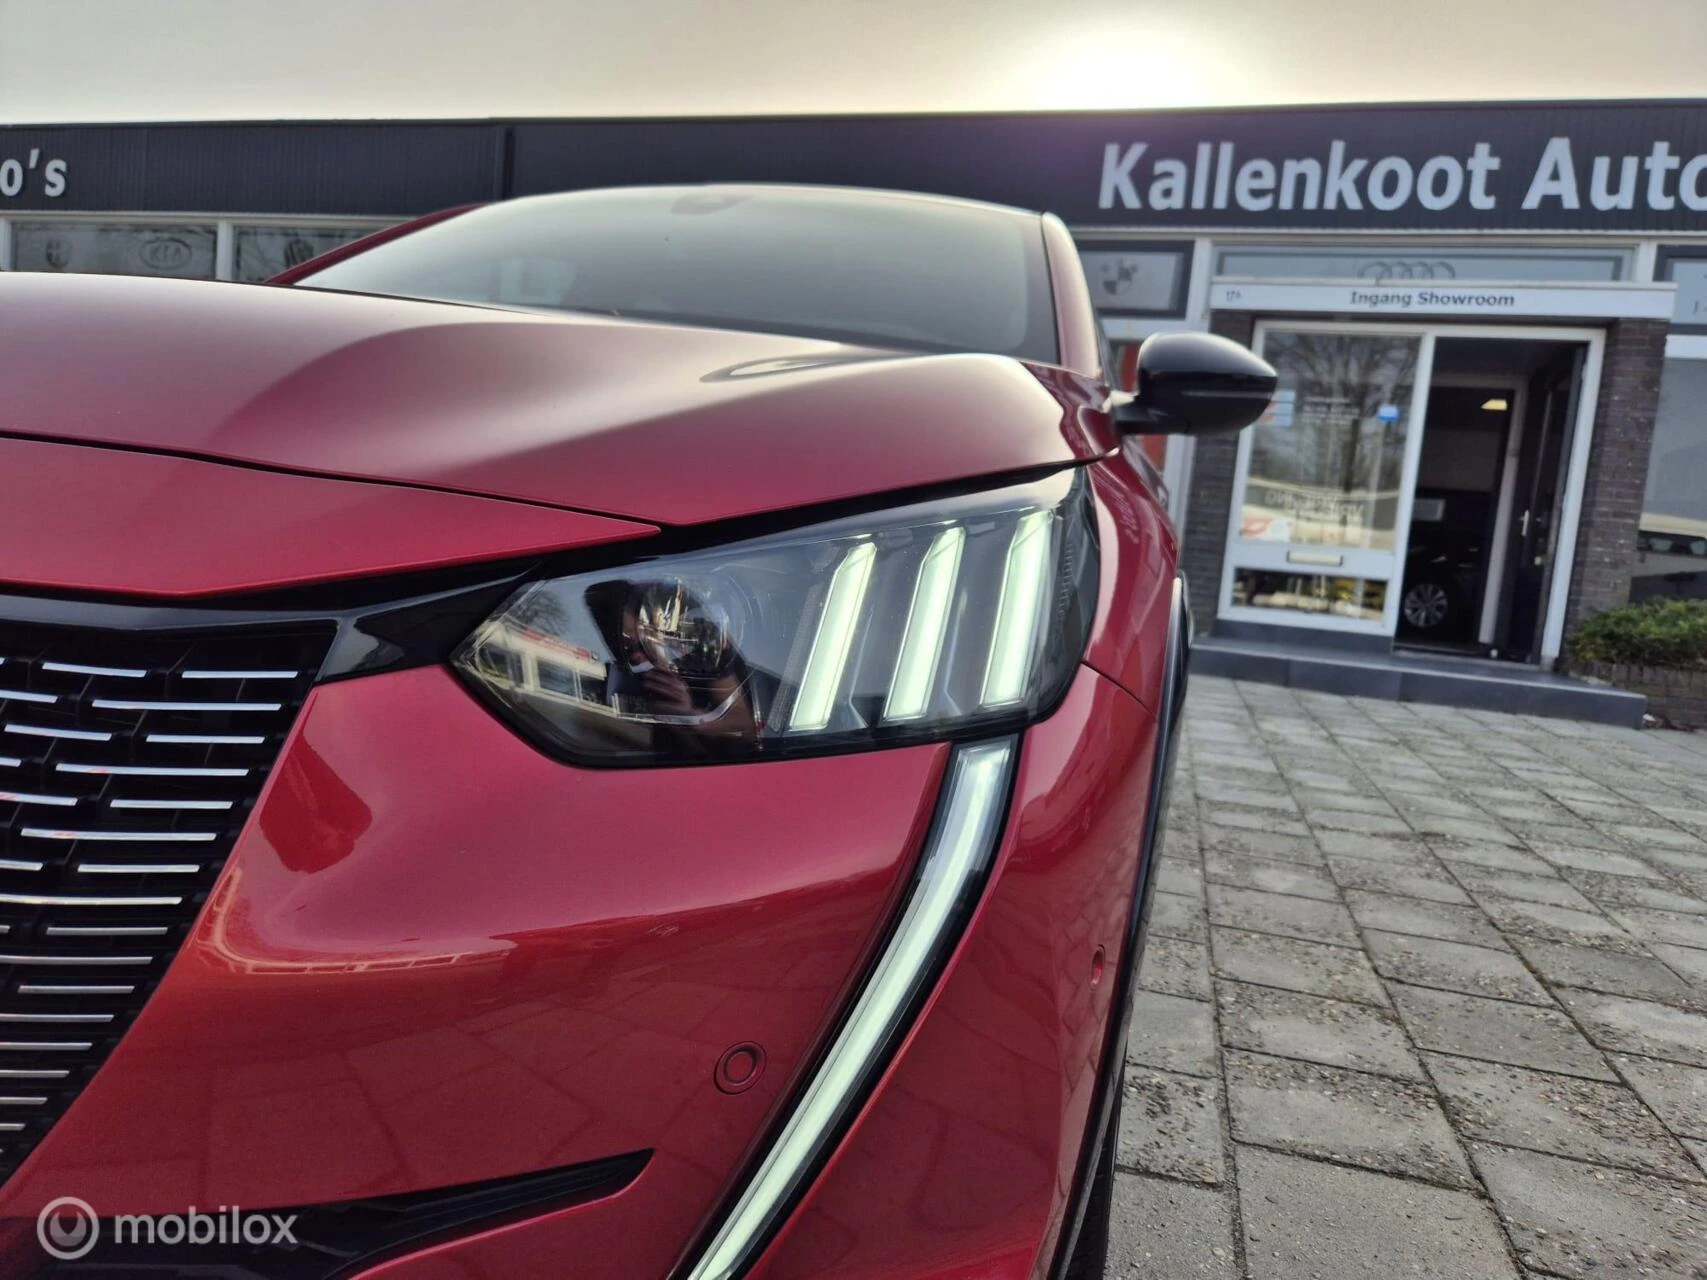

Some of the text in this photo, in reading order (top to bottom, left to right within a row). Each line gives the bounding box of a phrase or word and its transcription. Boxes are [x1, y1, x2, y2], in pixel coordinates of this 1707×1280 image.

[1098, 136, 1707, 211] Kallenkoot Auto
[1351, 291, 1515, 308] Ingang Showroom
